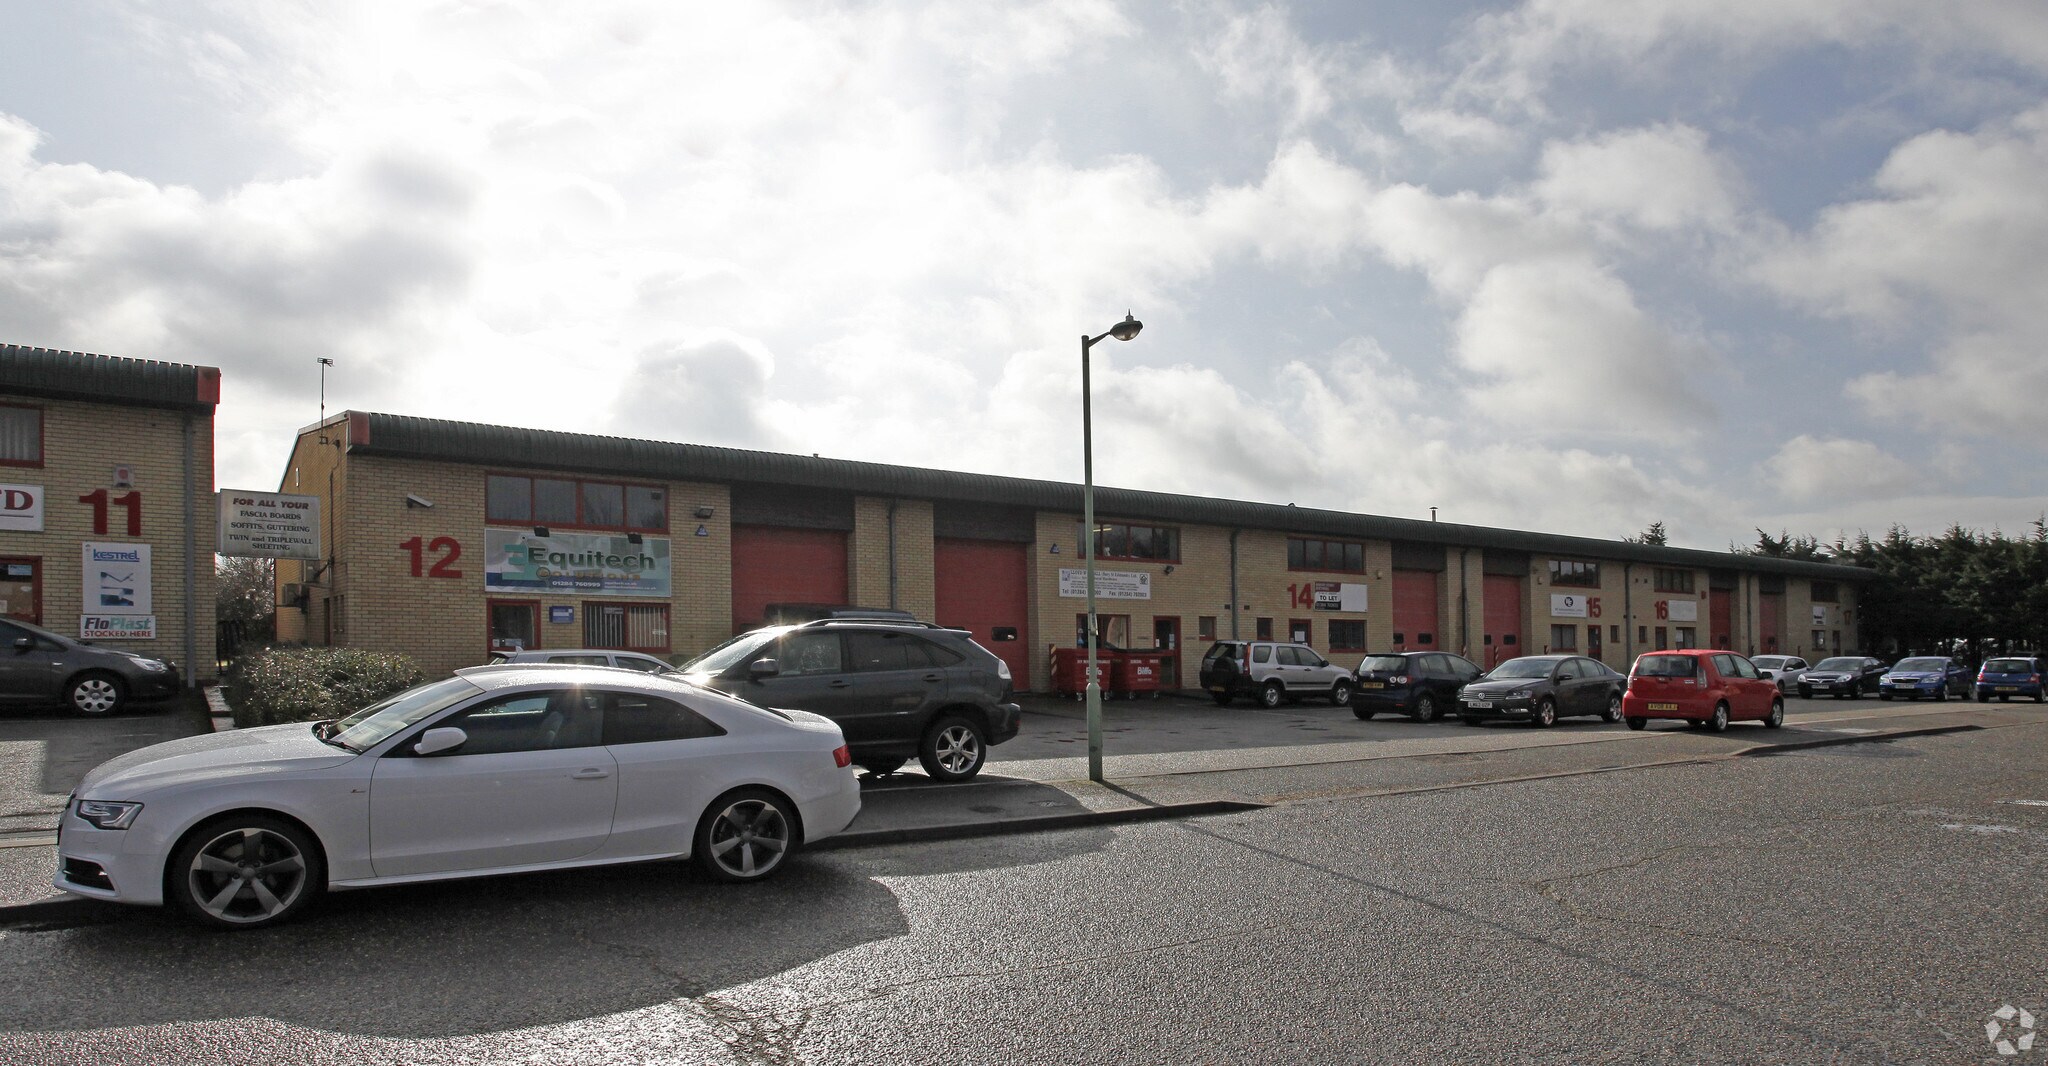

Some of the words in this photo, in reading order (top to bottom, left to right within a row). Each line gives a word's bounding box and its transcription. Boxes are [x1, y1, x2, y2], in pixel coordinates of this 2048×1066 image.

[0, 489, 34, 511] D
[233, 498, 254, 506] FOR
[79, 488, 142, 537] 11
[270, 512, 301, 520] BOARDS
[267, 524, 310, 533] GUTTERING
[267, 536, 313, 544] TRIPLEWALL
[400, 536, 463, 578] 12
[528, 547, 655, 570] Equitech
[1287, 583, 1314, 609] 14
[1586, 597, 1602, 618] 15
[1654, 600, 1668, 620] 16
[84, 617, 152, 630] FloPlast
